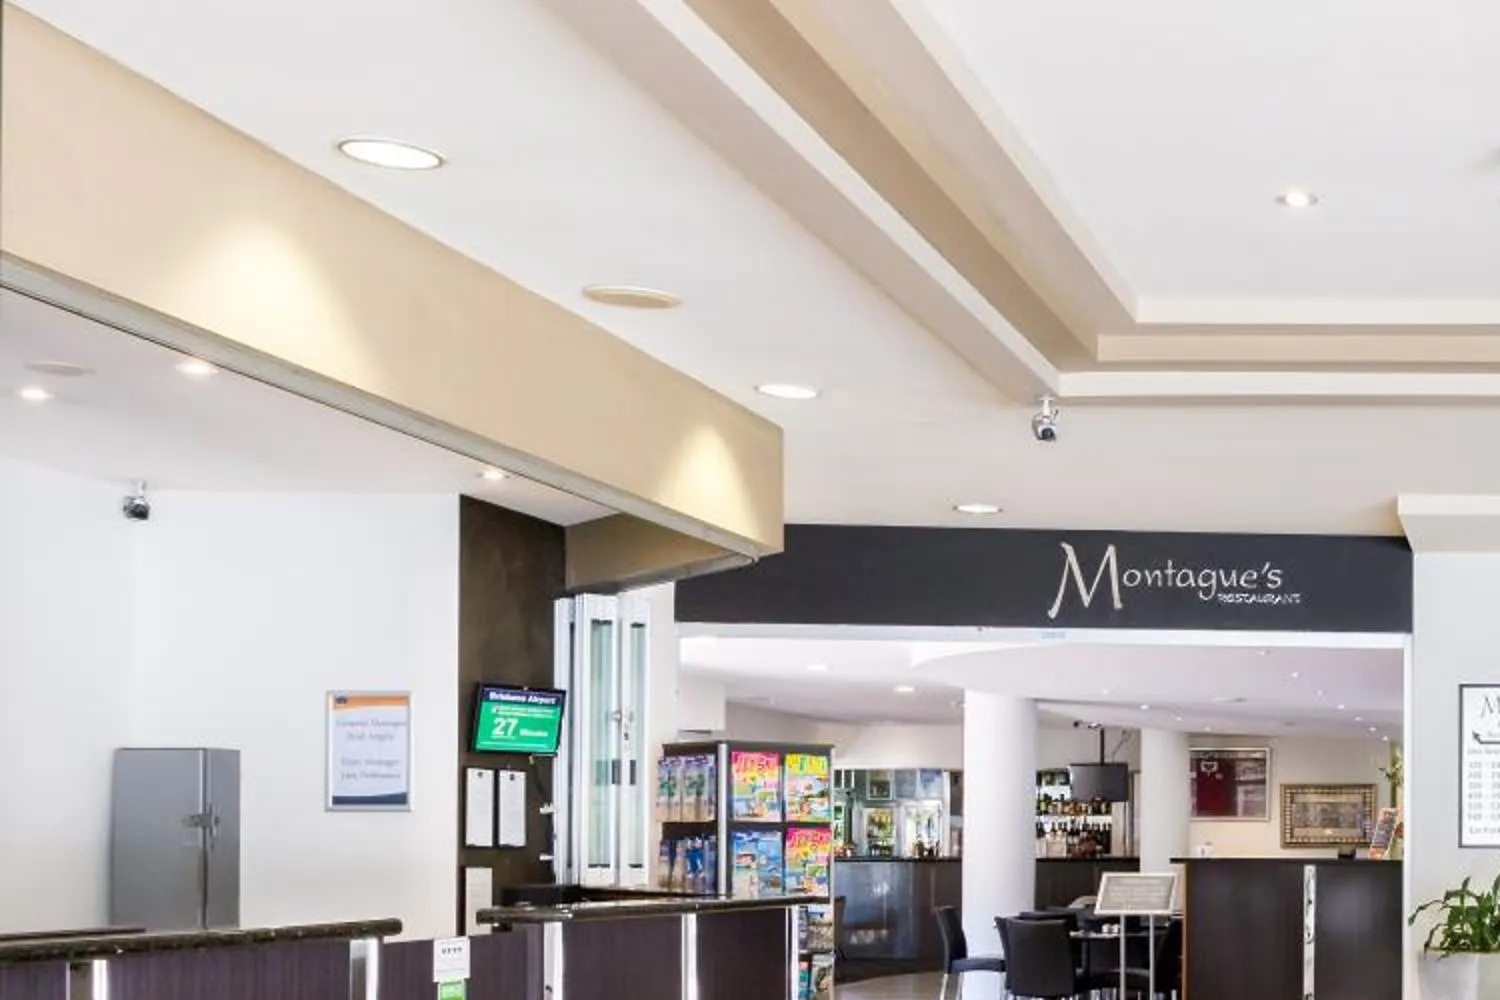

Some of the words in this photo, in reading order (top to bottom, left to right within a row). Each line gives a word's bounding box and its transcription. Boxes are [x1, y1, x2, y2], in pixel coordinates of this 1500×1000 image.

[1047, 541, 1284, 619] Montague's
[1216, 592, 1301, 605] RESTAURANT
[492, 717, 518, 738] 27
